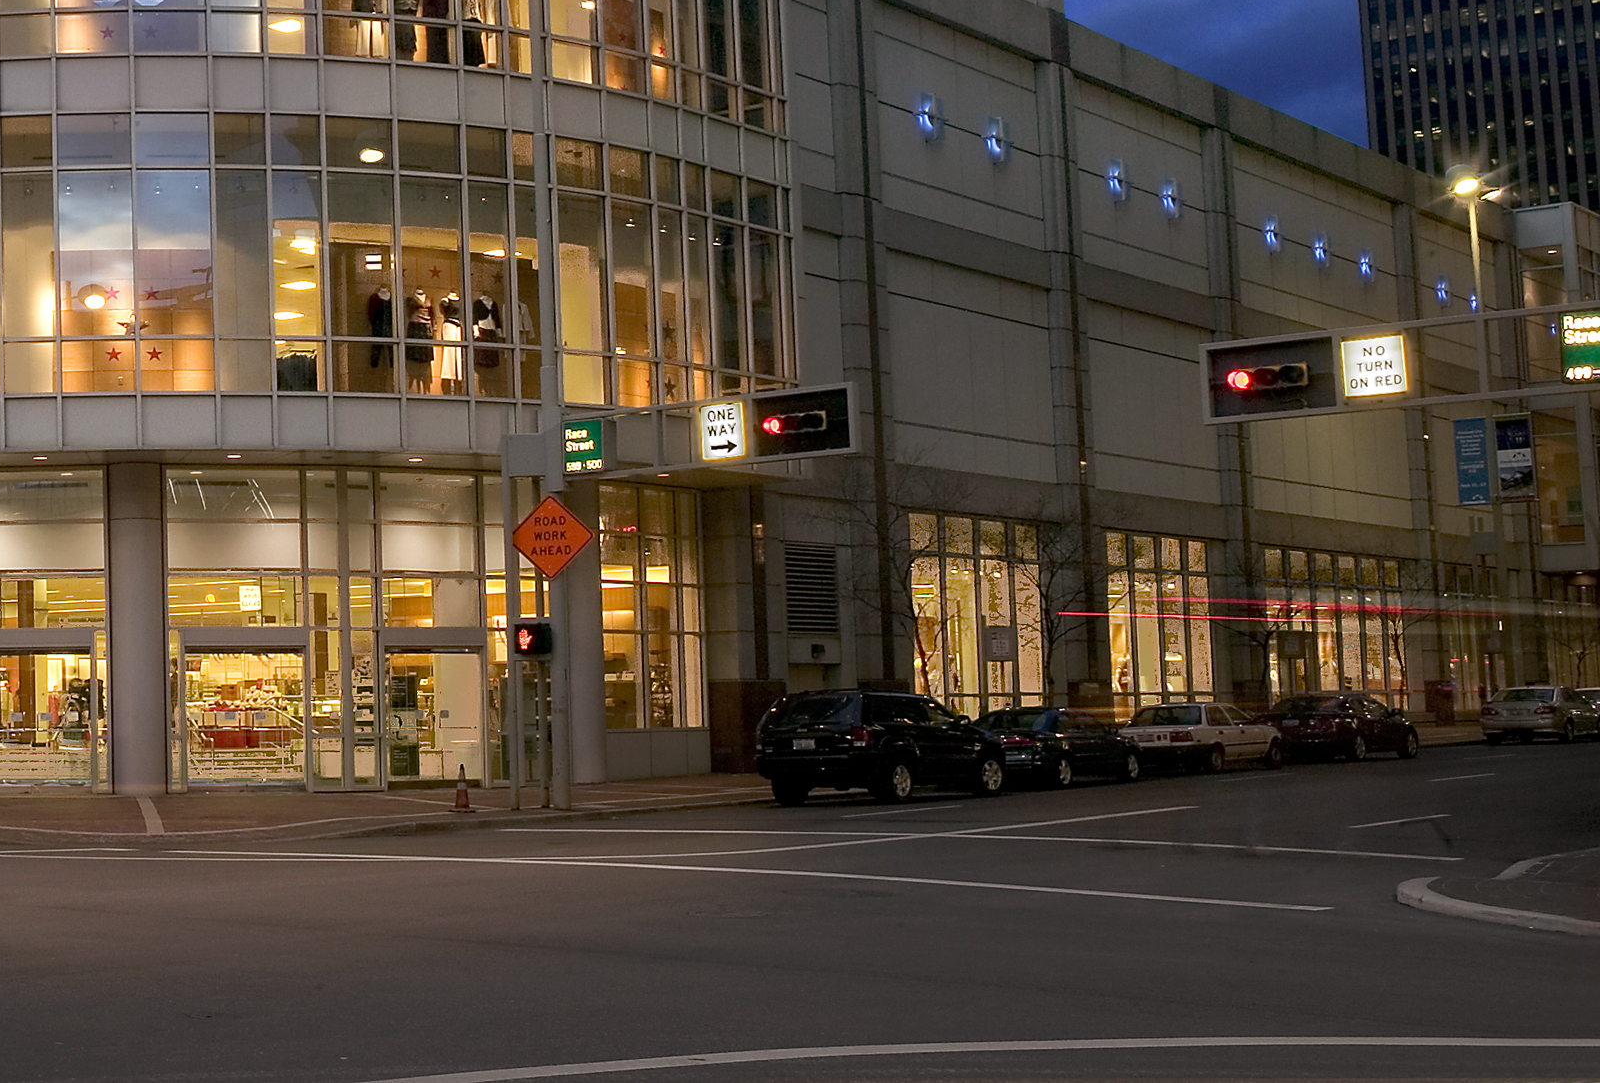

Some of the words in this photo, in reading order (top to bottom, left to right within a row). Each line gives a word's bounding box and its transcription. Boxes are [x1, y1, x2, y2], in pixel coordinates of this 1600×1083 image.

[1563, 329, 1600, 345] Stre
[1362, 345, 1385, 357] NO
[1356, 360, 1393, 372] TURN
[1349, 377, 1369, 389] ON
[1375, 374, 1402, 387] RED
[707, 407, 735, 422] ONE
[565, 429, 588, 440] Race
[706, 422, 737, 436] WAY
[565, 439, 595, 452] Street
[534, 515, 567, 527] ROAD
[533, 530, 568, 541] WORK
[530, 544, 572, 557] AHEAD
